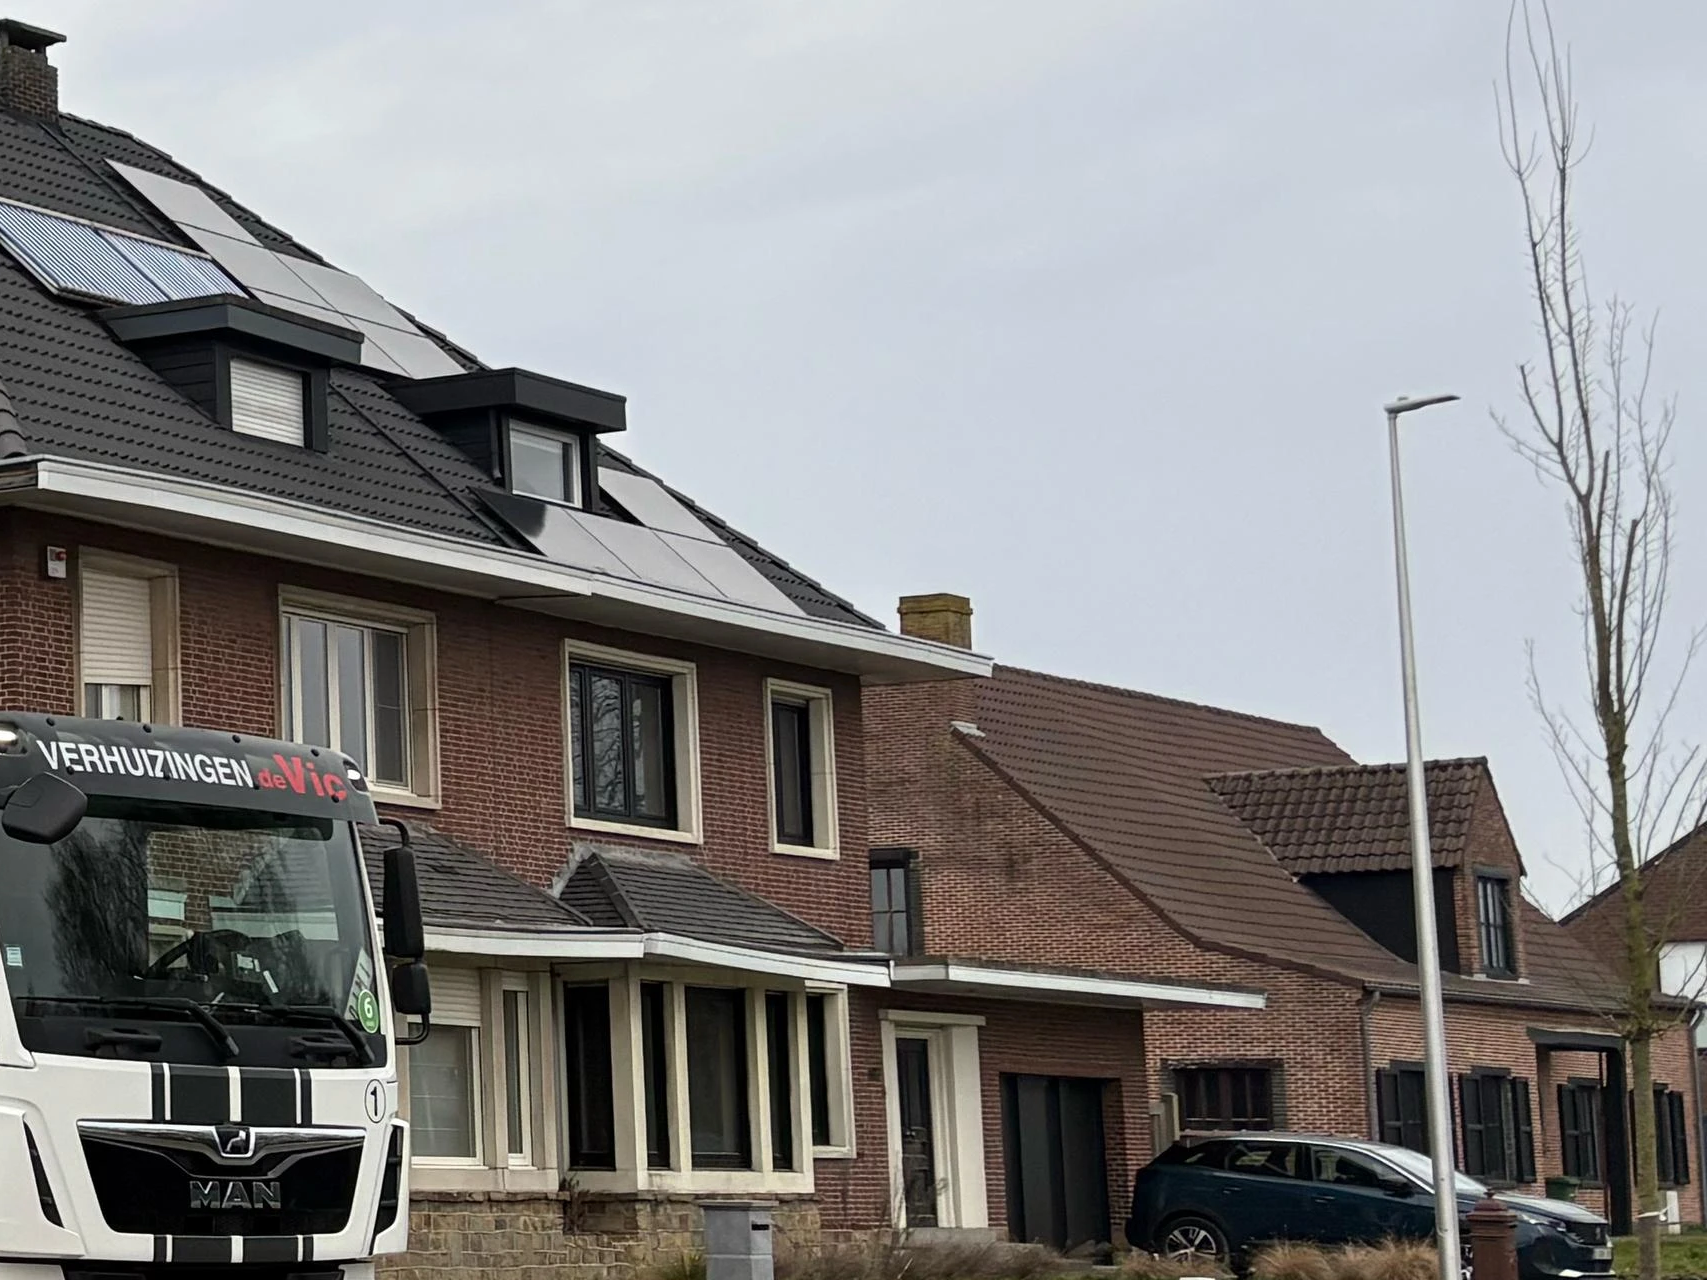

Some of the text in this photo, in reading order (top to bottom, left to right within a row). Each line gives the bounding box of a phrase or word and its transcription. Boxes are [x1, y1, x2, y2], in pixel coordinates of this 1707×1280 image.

[37, 740, 255, 789] VERHUIZINGEN
[364, 997, 374, 1019] 6
[370, 1086, 378, 1117] 1
[189, 1180, 282, 1209] MAN
